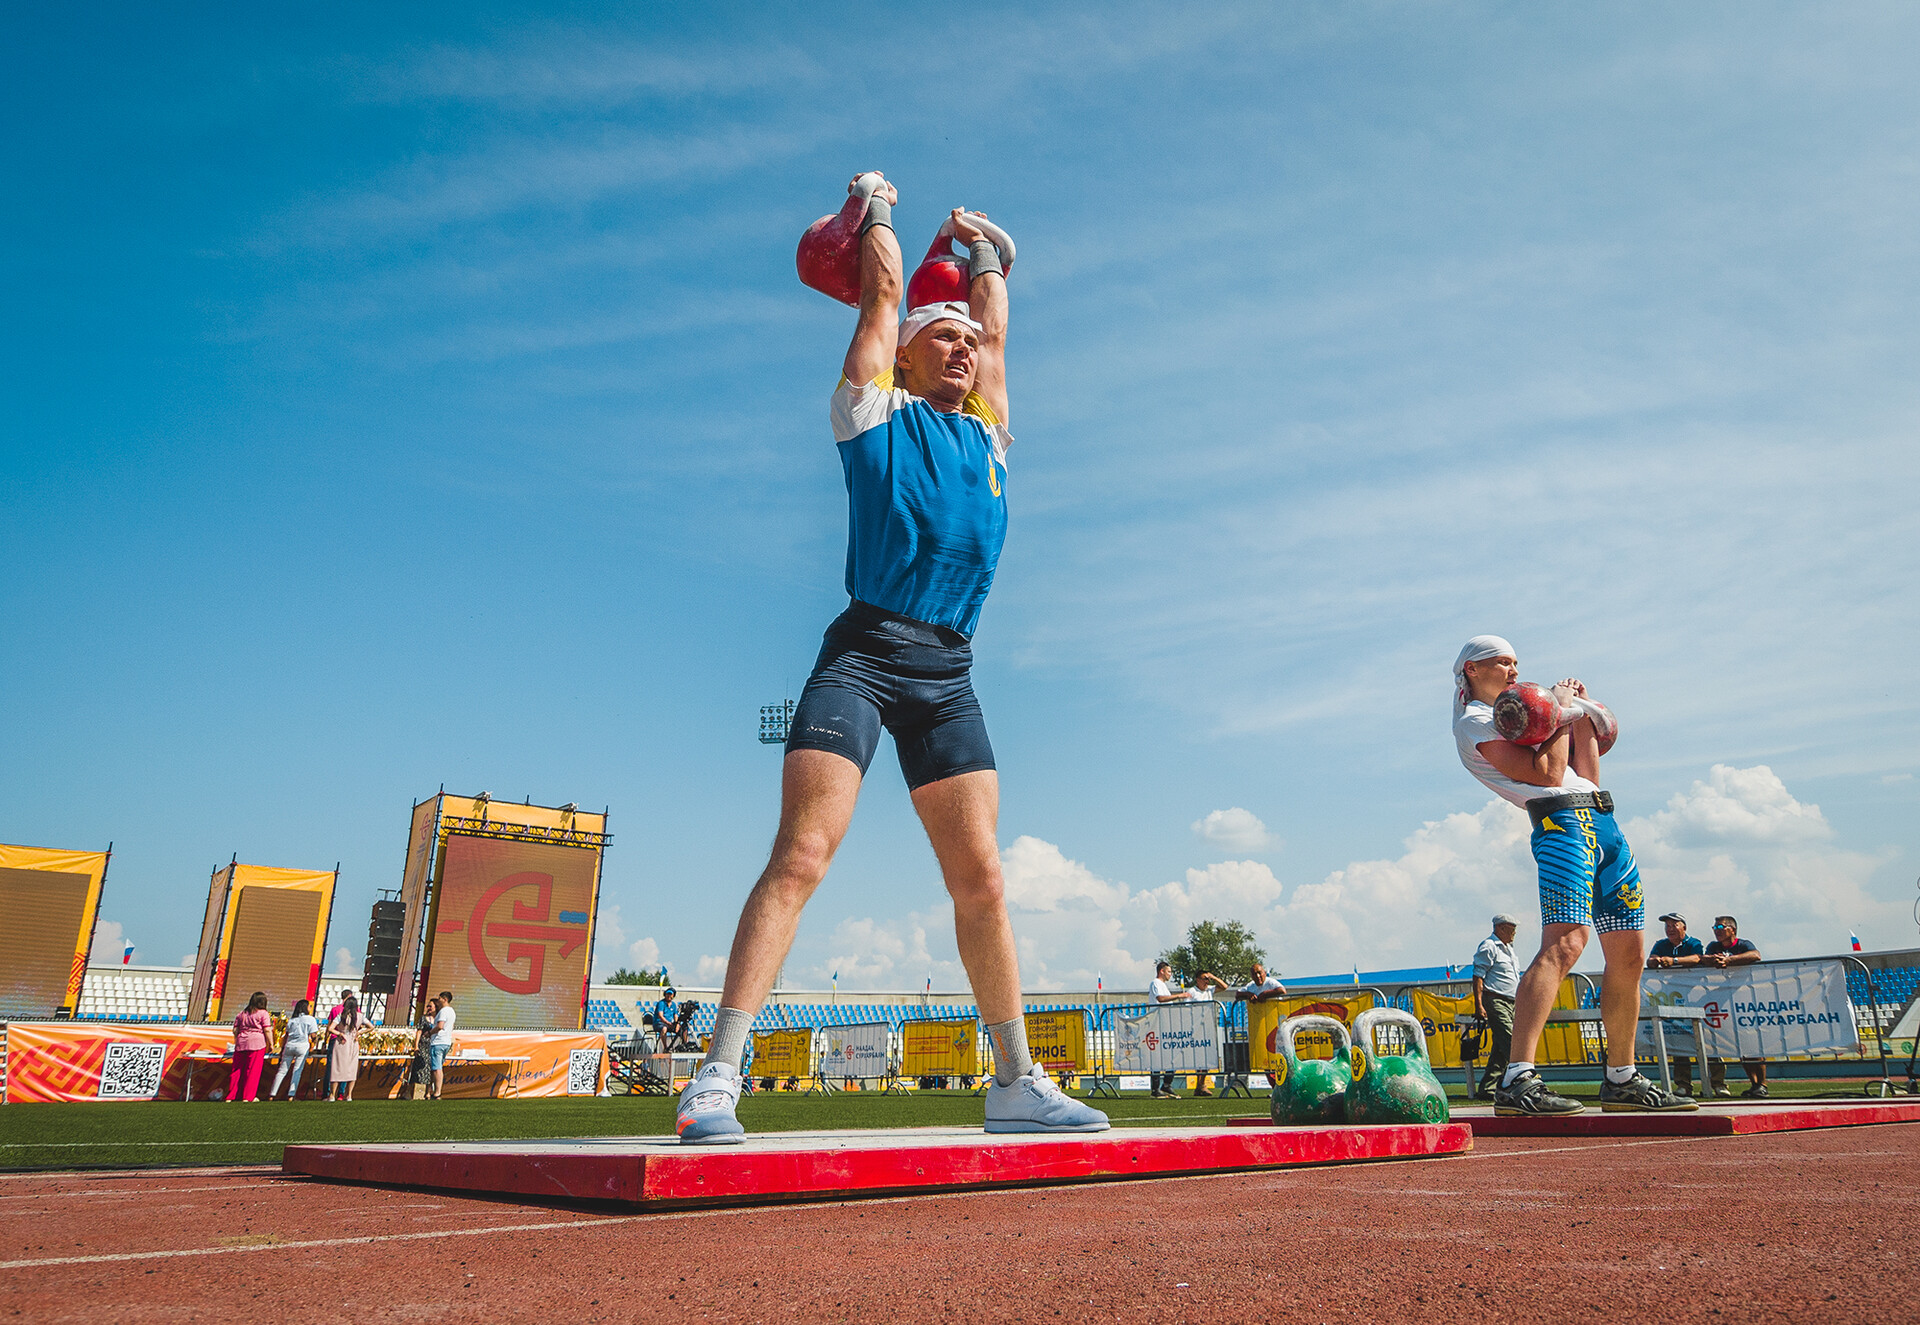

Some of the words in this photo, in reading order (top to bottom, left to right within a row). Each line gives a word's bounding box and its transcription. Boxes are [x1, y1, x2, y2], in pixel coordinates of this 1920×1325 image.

[1735, 1000, 1800, 1014] НААДАН
[1738, 1012, 1840, 1027] СУРХАРБААН
[1162, 1031, 1193, 1040] НААДАН
[1162, 1039, 1211, 1050] СУРХАРБААН
